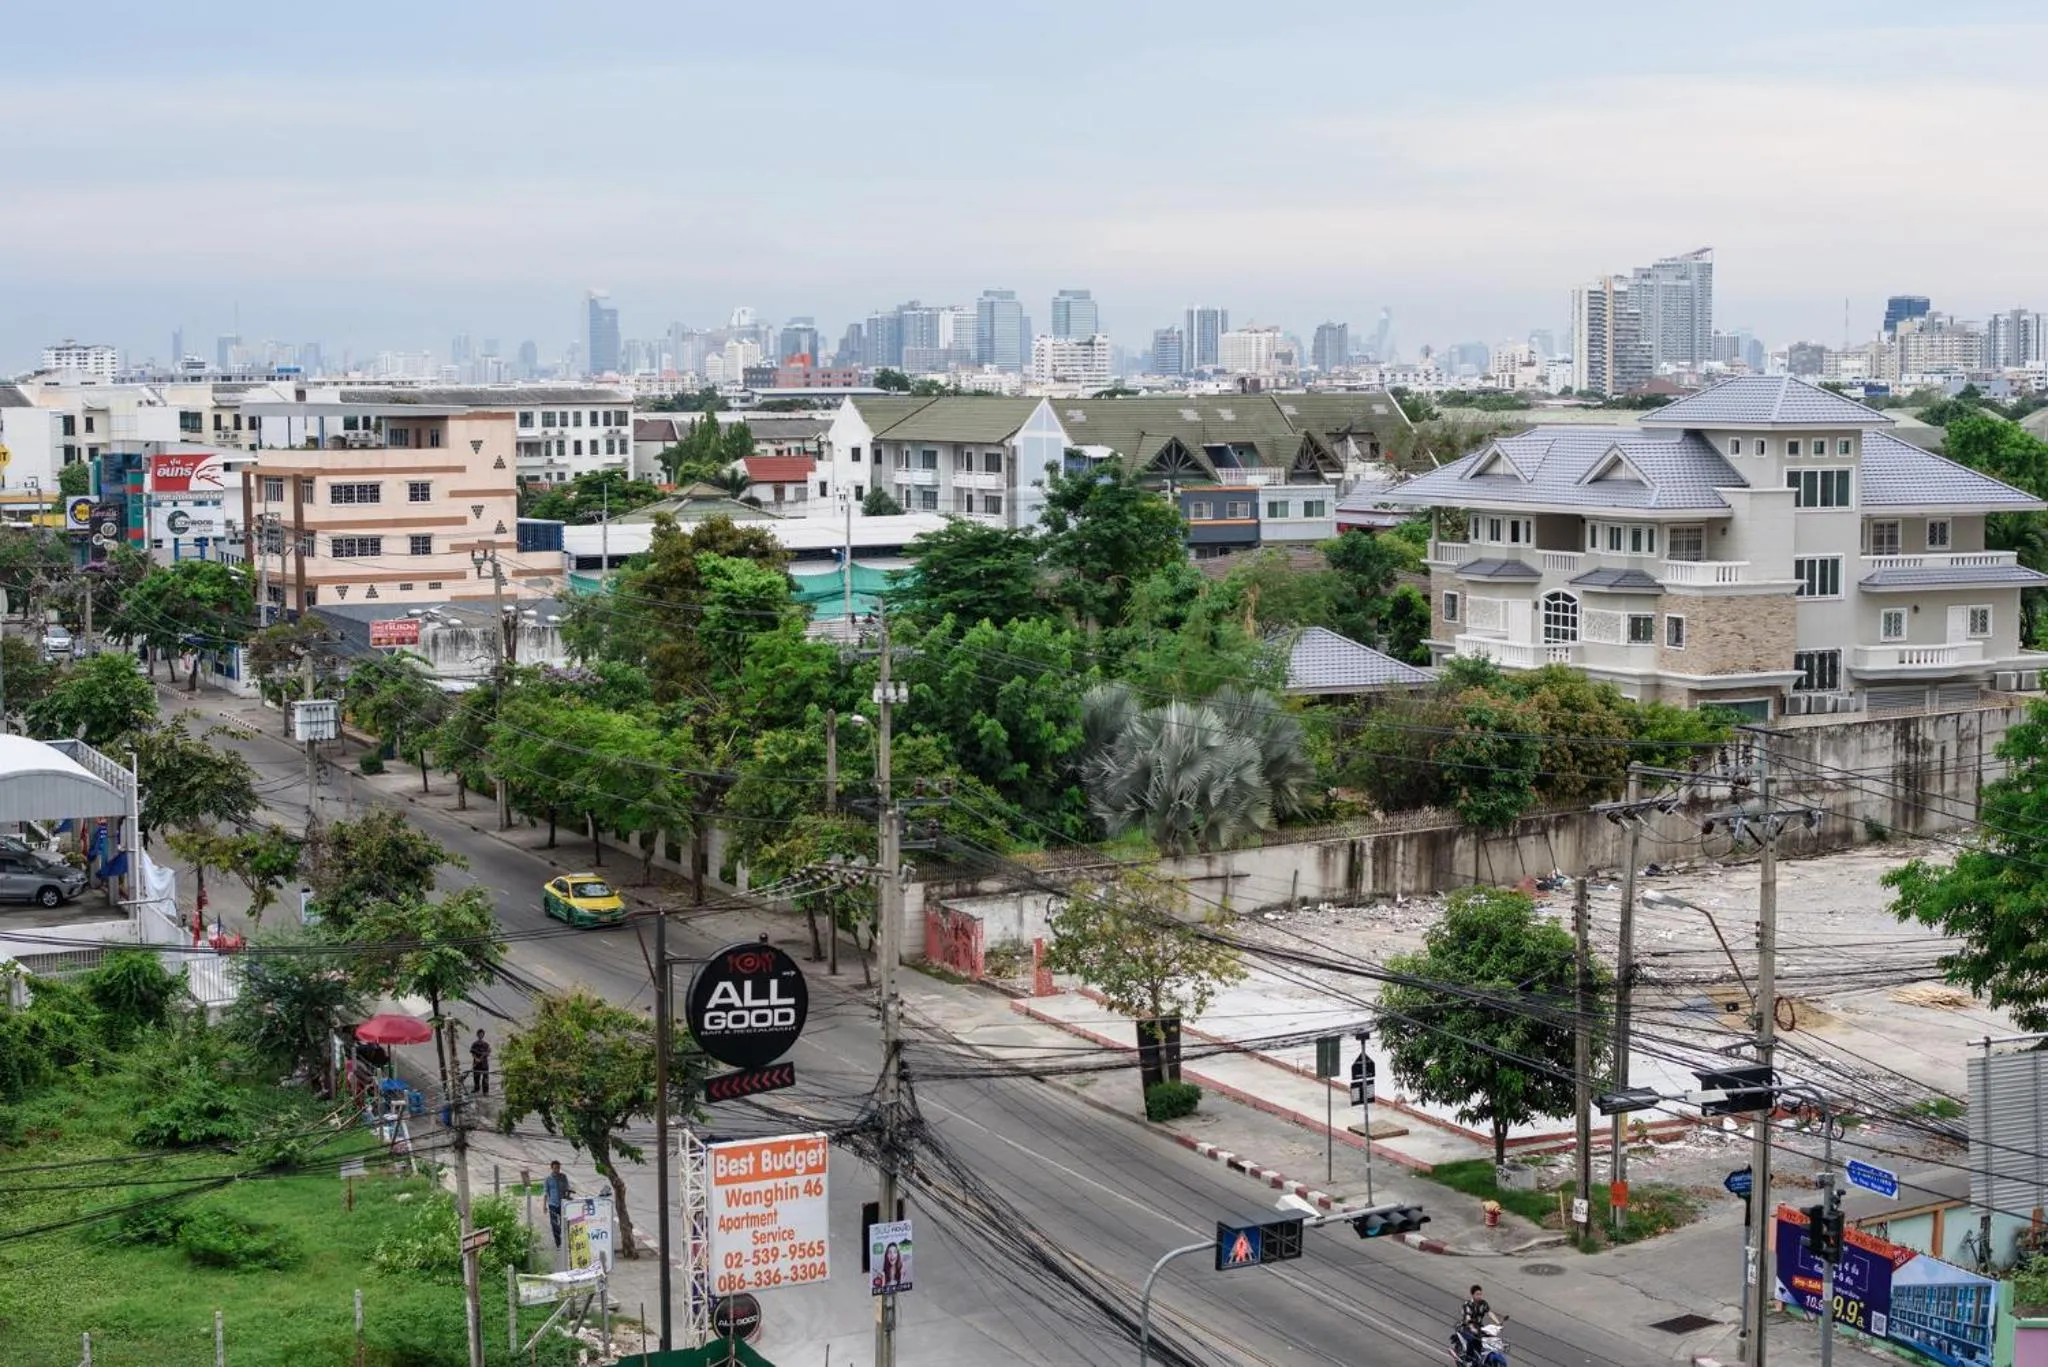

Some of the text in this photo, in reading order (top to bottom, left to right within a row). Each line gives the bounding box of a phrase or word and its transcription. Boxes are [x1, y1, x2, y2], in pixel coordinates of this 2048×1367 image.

[706, 979, 795, 1008] ALL
[704, 1008, 795, 1030] GOOD
[716, 1143, 825, 1178] Best Budget
[725, 1177, 824, 1208] Wanghin 46
[718, 1208, 778, 1235] Apartment
[751, 1226, 795, 1245] Service
[724, 1240, 825, 1269] 02-539-9565
[718, 1262, 827, 1292] 086-336-3304
